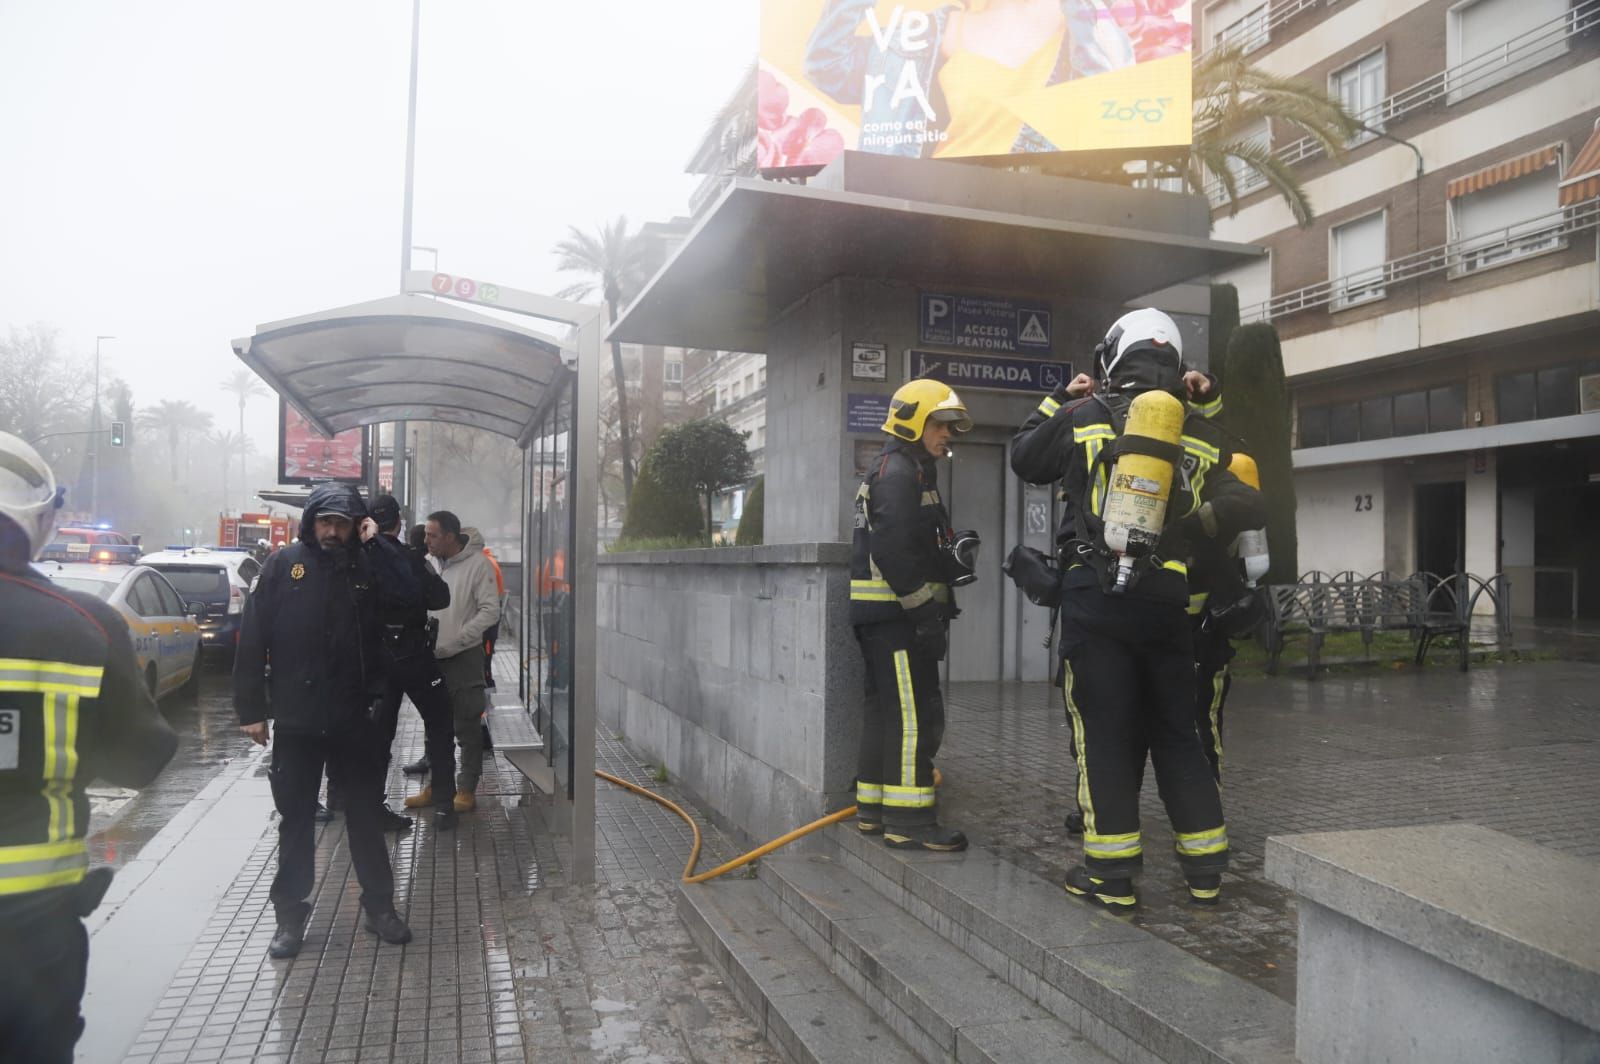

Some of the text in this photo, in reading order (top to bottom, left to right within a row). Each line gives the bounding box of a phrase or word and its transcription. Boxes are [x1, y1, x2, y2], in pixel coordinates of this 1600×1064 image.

[863, 119, 924, 133] como en
[863, 130, 949, 147] ningún sitio
[439, 276, 447, 289] 7
[461, 280, 471, 295] 9
[482, 287, 497, 299] 12
[928, 299, 948, 326] P
[964, 324, 1009, 337] ACCESO
[956, 336, 1016, 351] PEATONAL
[947, 361, 1033, 383] ENTRADA
[1356, 495, 1373, 512] 23
